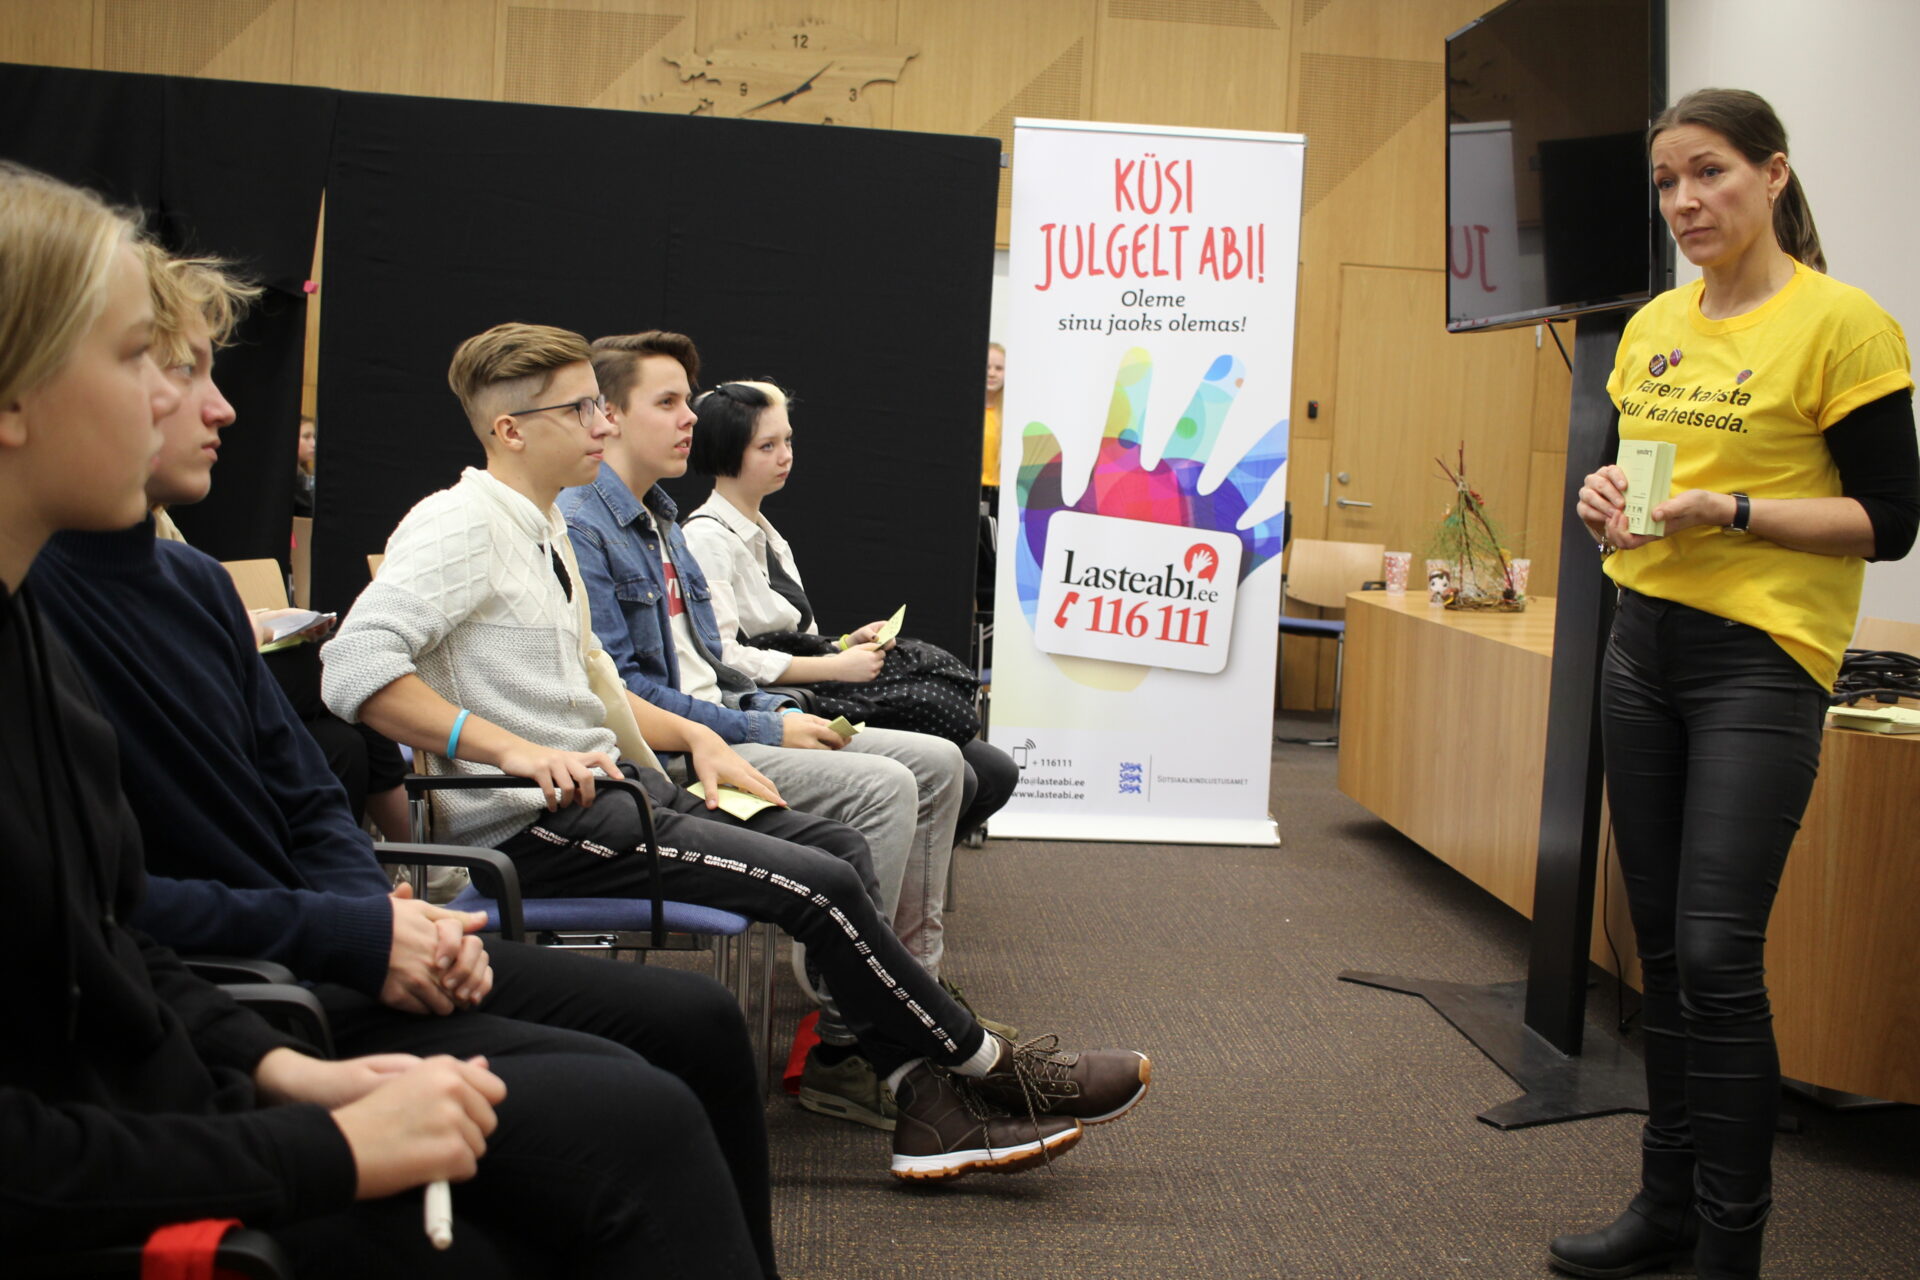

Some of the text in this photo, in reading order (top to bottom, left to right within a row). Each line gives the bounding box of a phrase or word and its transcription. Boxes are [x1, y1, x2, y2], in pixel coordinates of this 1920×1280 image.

[792, 35, 808, 49] 12
[849, 88, 858, 102] 3
[1115, 152, 1193, 214] KÜSI
[1034, 222, 1265, 291] JULGELT ABI!
[1121, 289, 1186, 308] Oleme
[1058, 312, 1247, 336] sinu jaoks olemas!
[1621, 396, 1748, 434] kui kahetseda.
[1060, 549, 1219, 603] Lasteabi.ee
[1084, 595, 1210, 647] 116 111
[1041, 758, 1073, 767] 116111
